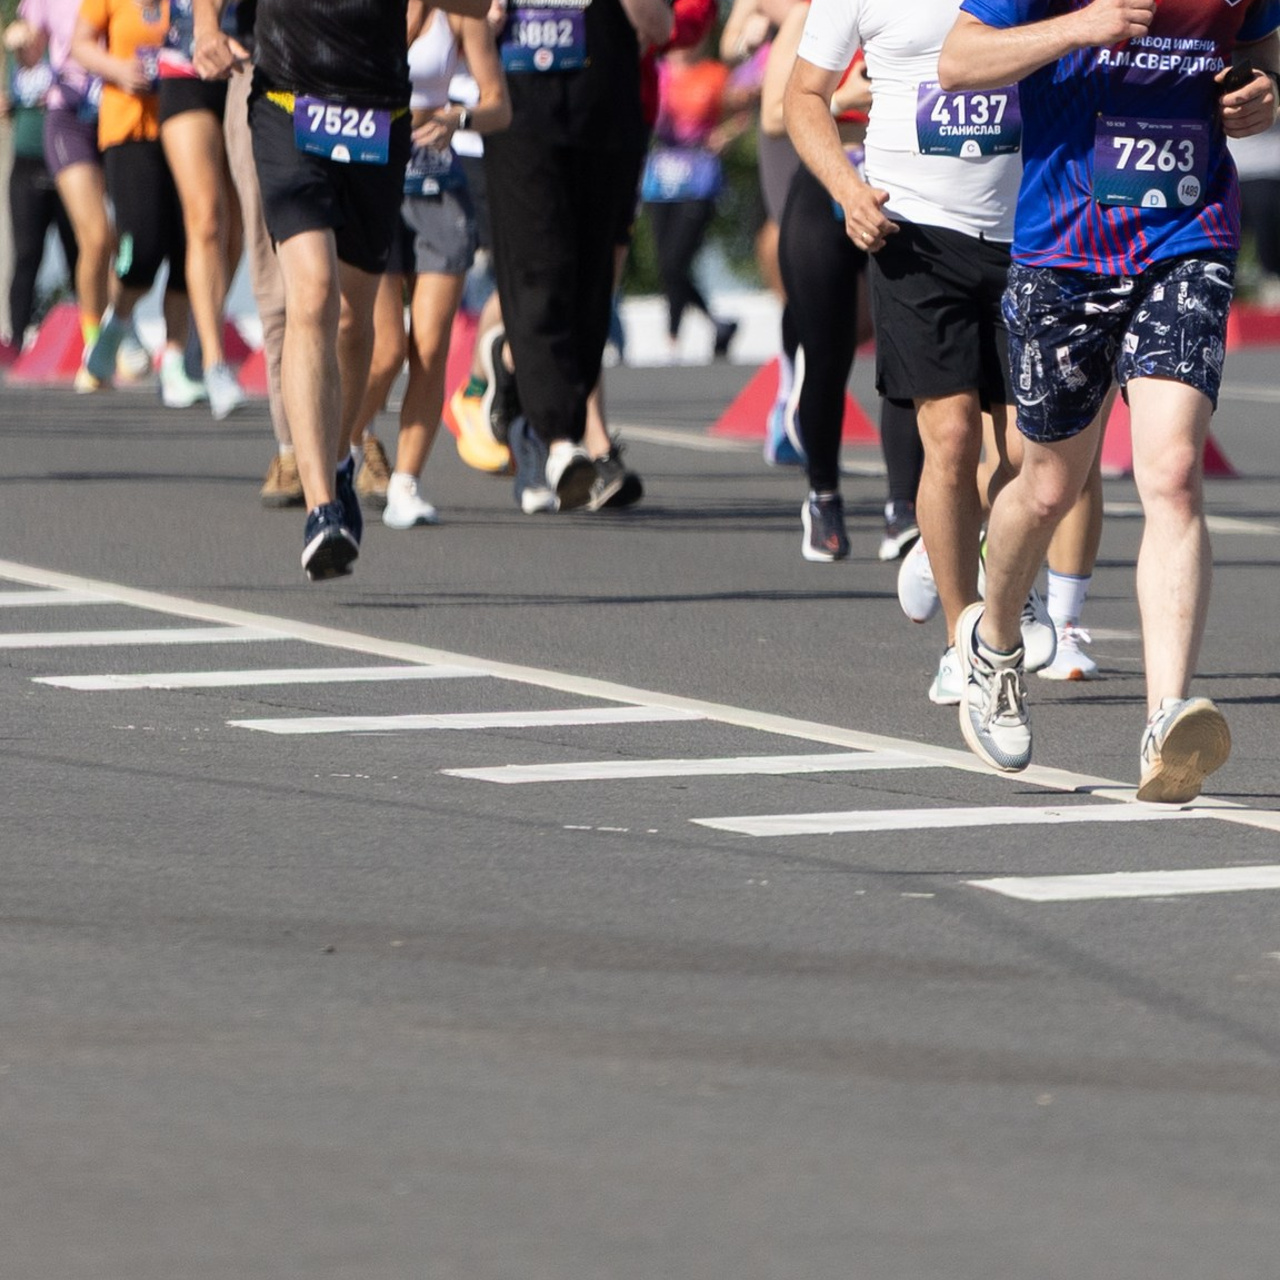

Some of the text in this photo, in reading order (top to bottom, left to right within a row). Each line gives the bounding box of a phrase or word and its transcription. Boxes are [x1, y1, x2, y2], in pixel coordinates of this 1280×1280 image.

[1130, 36, 1215, 51] ЗАВОД ИМЕНИ
[308, 104, 376, 138] 7526
[931, 95, 1007, 125] 4137
[939, 125, 1001, 136] СТАНИСЛАВ
[1113, 137, 1195, 172] 7263
[1150, 195, 1159, 205] D
